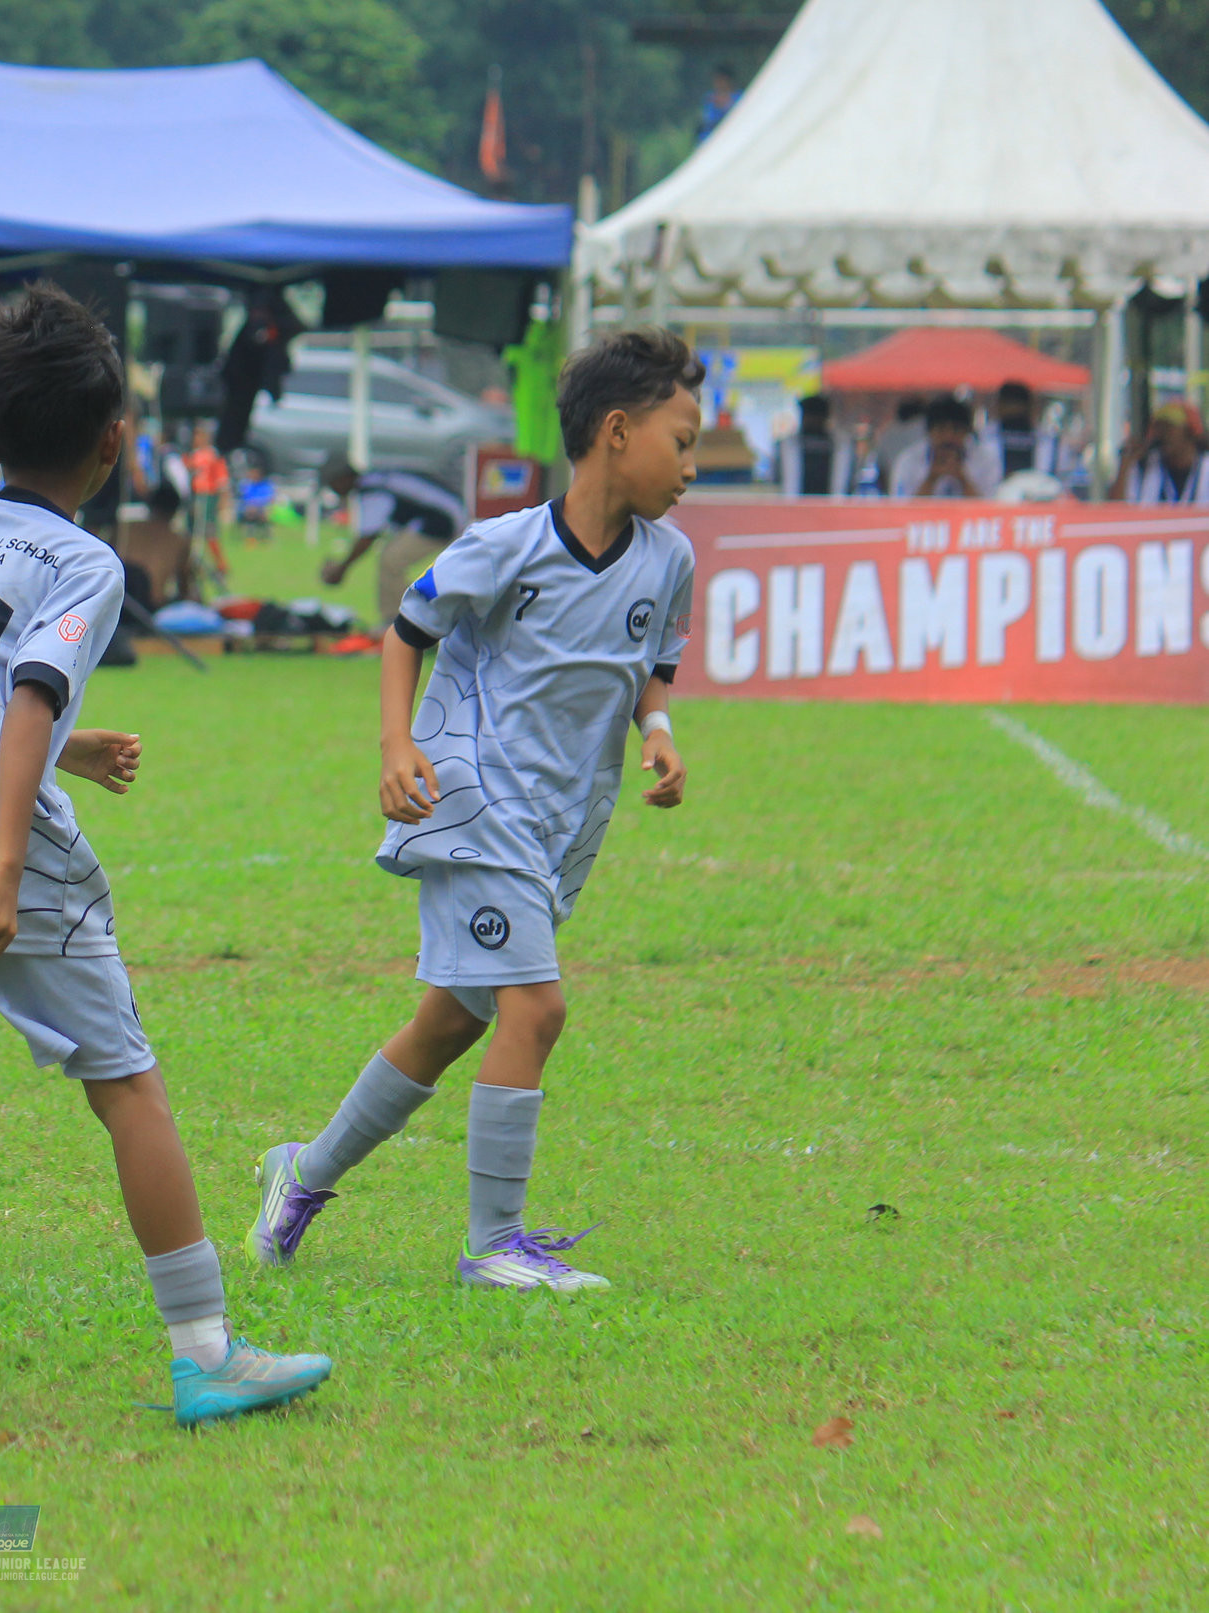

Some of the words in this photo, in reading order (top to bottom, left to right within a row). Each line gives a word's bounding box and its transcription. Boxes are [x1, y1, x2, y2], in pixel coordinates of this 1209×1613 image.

[906, 520, 951, 554] YOU
[958, 517, 1003, 549] ARE
[1012, 514, 1056, 547] THE
[6, 538, 60, 569] SCHOOL
[515, 584, 539, 621] 7
[704, 539, 1209, 685] CHAMPION
